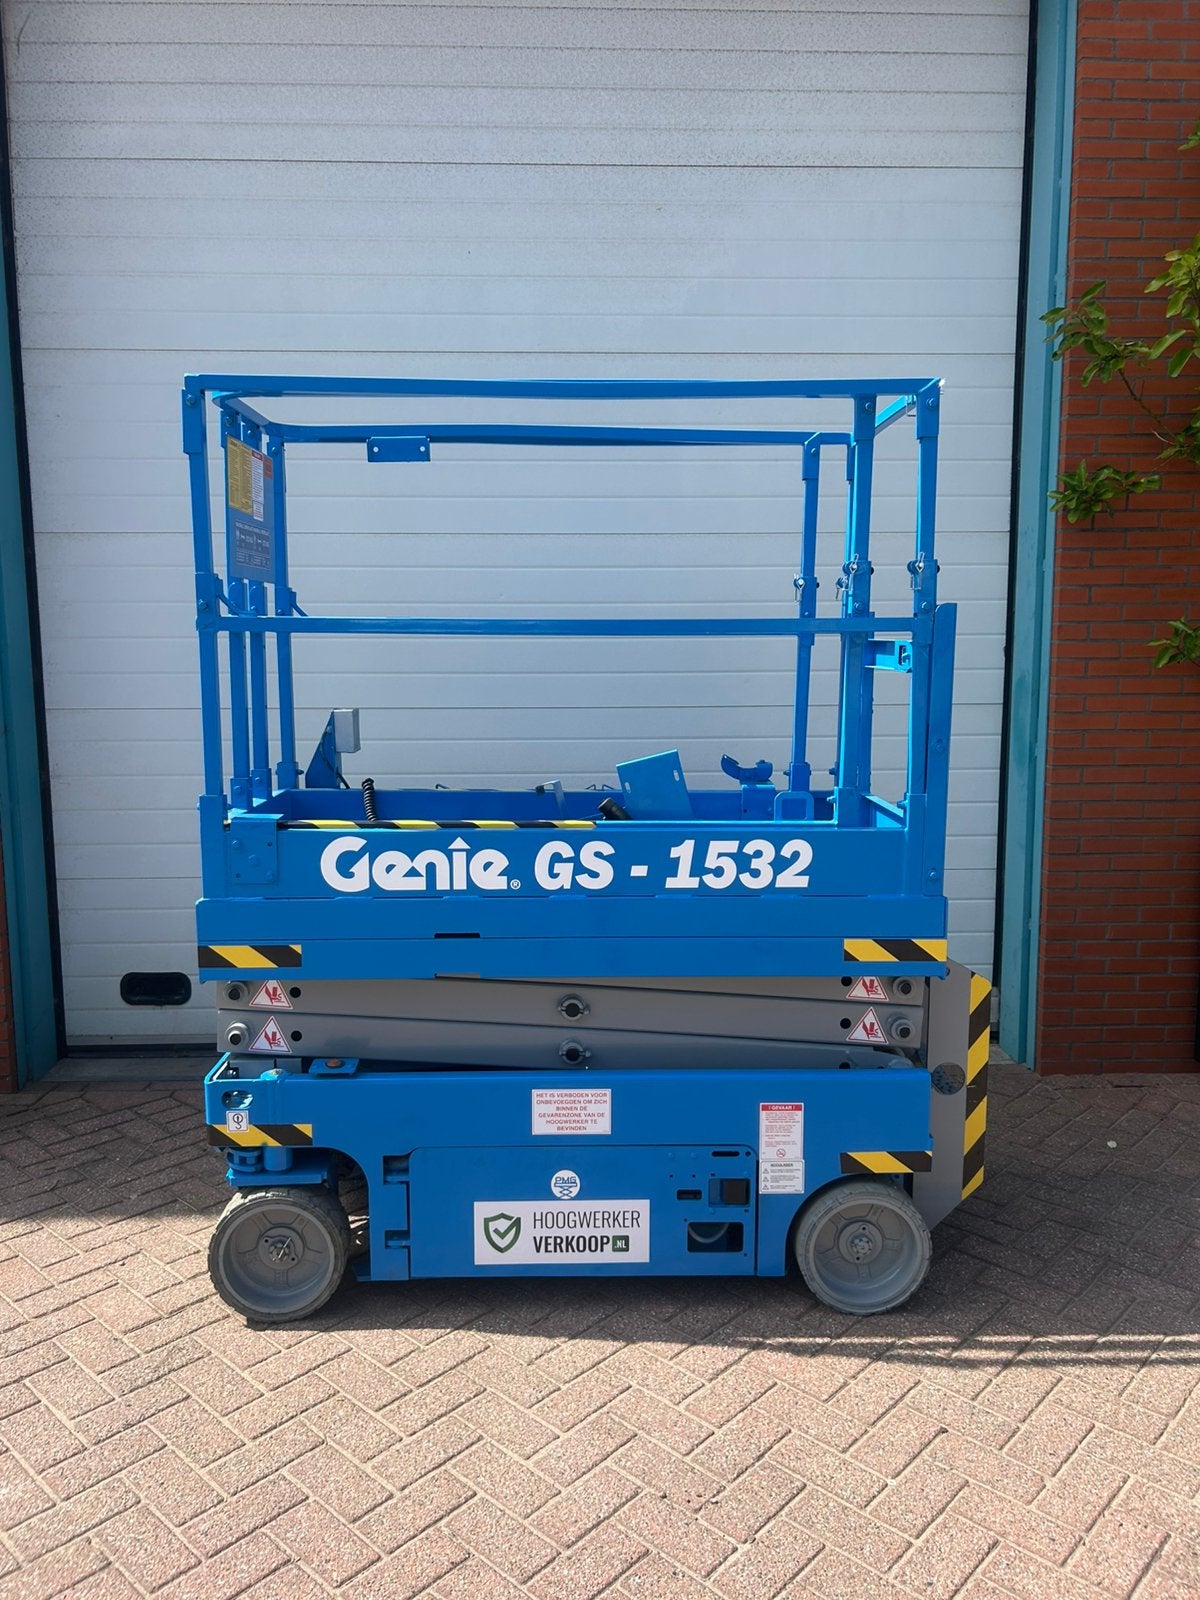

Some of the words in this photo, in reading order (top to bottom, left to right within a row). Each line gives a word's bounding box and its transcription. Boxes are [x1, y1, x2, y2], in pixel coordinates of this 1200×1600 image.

[534, 840, 616, 890] GS
[665, 838, 814, 890] 1532
[554, 1176, 577, 1184] PMG
[533, 1210, 641, 1229] HOOGWERKER
